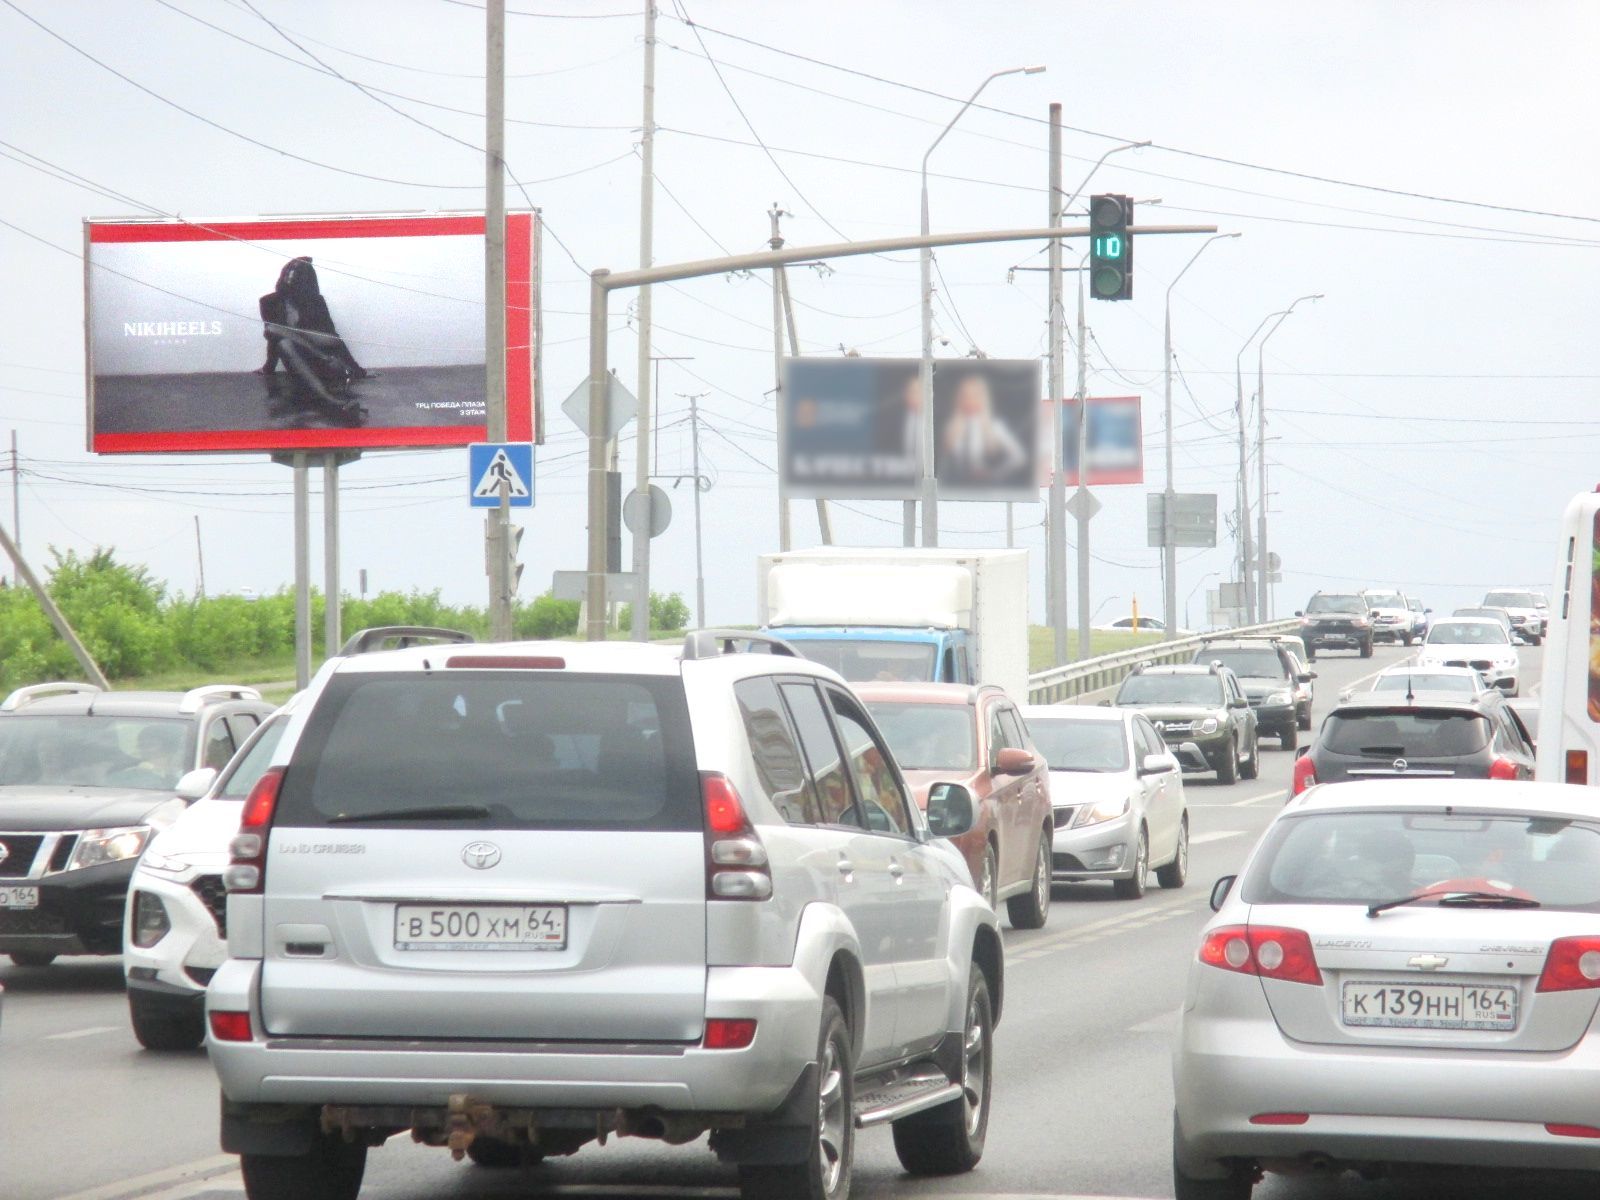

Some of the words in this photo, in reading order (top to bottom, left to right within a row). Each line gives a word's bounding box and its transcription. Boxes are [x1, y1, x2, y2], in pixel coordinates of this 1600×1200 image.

[1096, 237, 1120, 257] 10
[123, 321, 222, 336] NIKIHEELS
[415, 402, 430, 410] ТРЦ
[430, 401, 461, 409] ПОБЕДА
[524, 932, 545, 940] RUS
[1467, 990, 1508, 1012] 164
[1475, 1011, 1496, 1019] RUS
